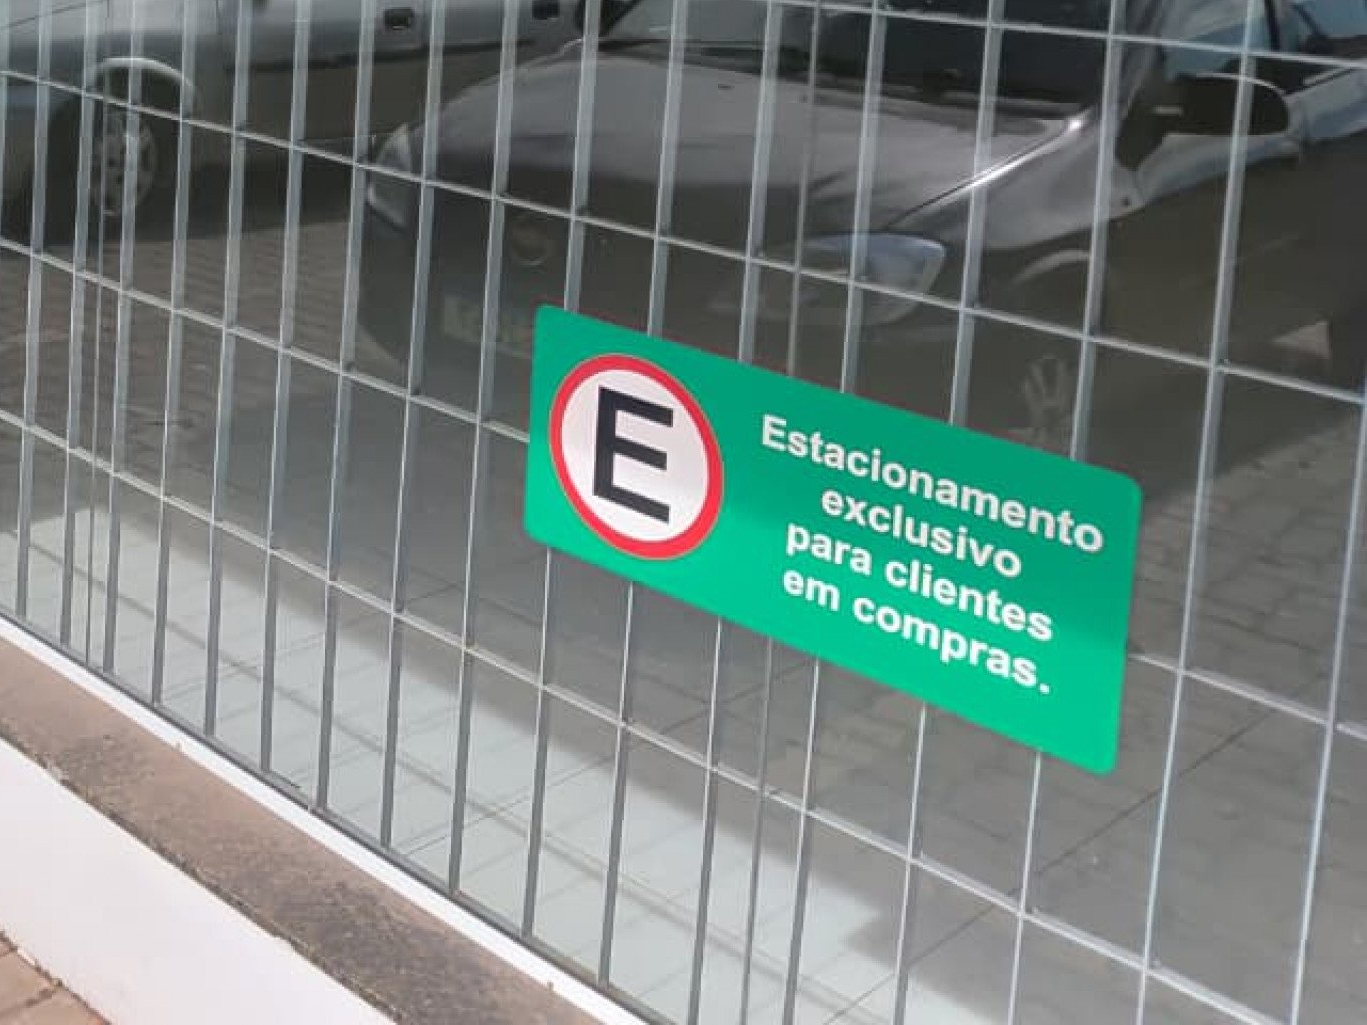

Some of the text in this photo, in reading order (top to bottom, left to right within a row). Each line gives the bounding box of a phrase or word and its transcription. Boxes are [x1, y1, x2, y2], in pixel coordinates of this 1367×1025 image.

[592, 385, 674, 524] E
[760, 412, 1106, 555] Estacionamento
[785, 521, 1054, 643] para clientes
[820, 486, 1022, 578] exclusivo
[782, 566, 1052, 695] em compras.
